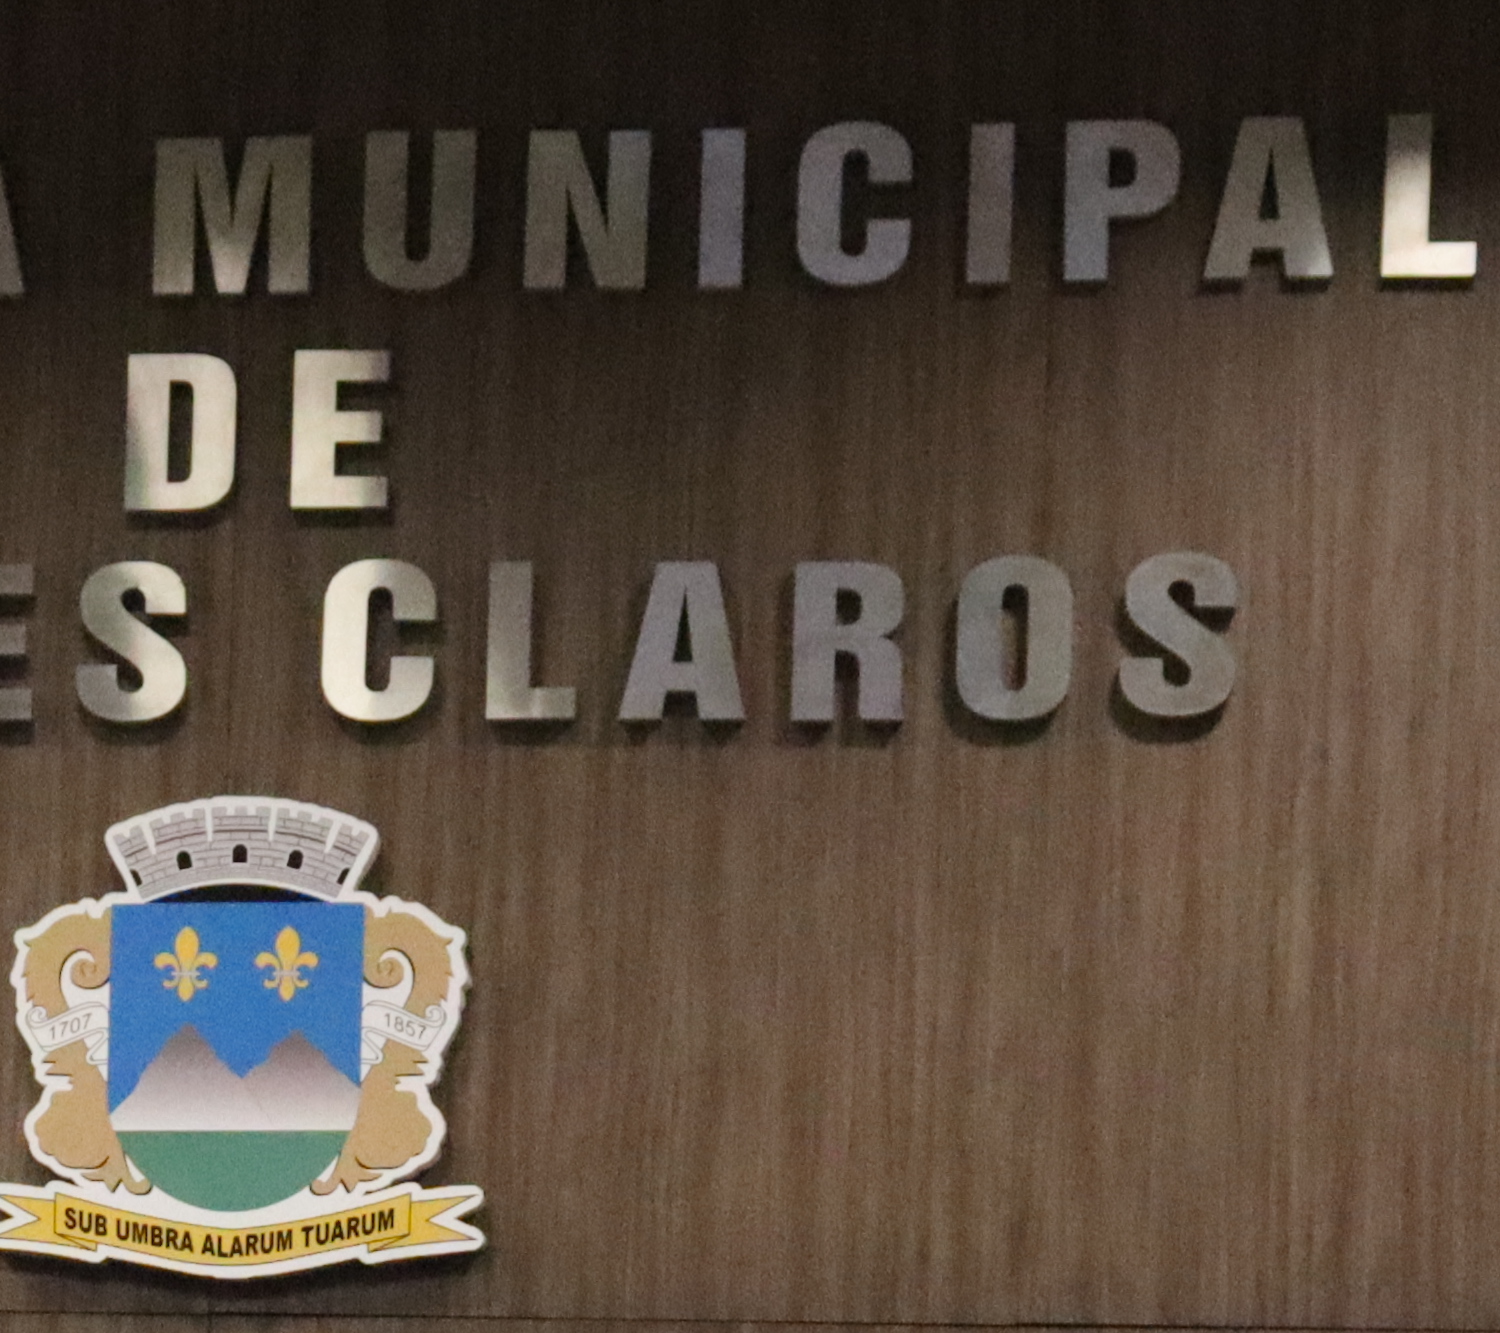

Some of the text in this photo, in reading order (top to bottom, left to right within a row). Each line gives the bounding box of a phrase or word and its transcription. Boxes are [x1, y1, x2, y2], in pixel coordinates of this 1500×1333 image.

[152, 113, 1478, 296] MUNICIPAL
[123, 348, 389, 511] DE
[318, 550, 1238, 724] CLAROS
[48, 1013, 93, 1040] 1707
[383, 1013, 427, 1040] 1857
[64, 1207, 395, 1257] SUB UMBRA ALARUM TUARUM
